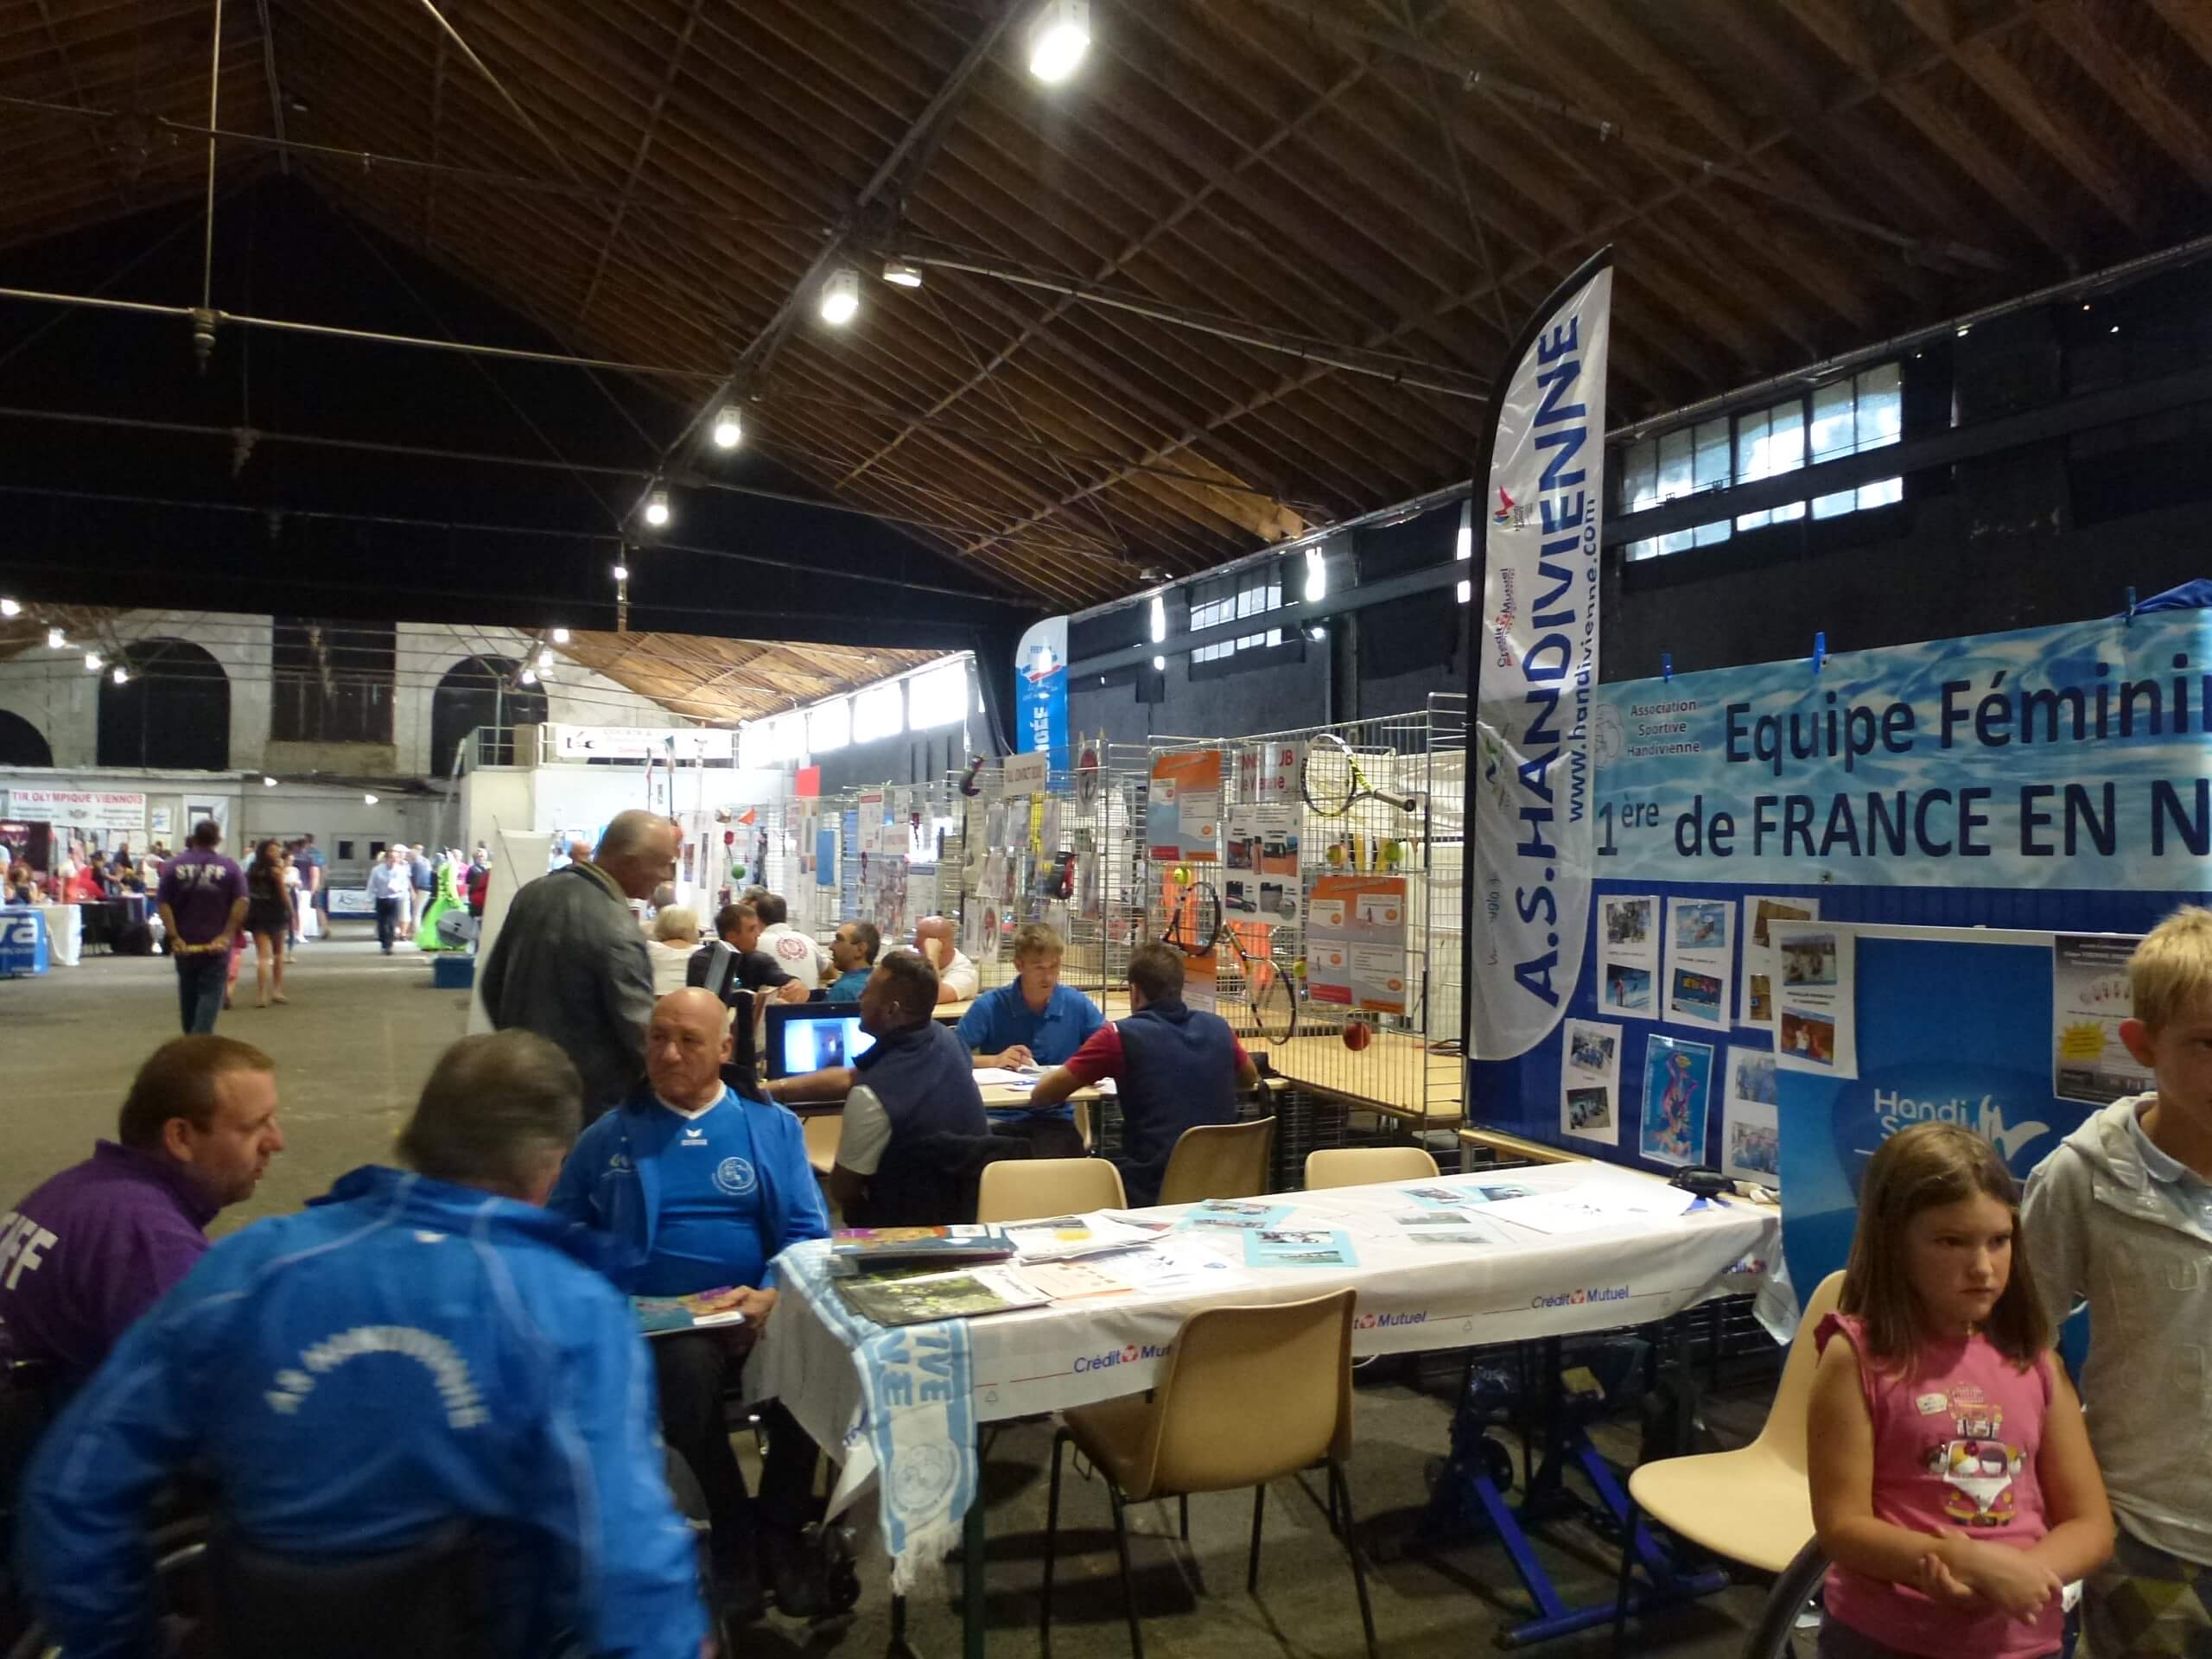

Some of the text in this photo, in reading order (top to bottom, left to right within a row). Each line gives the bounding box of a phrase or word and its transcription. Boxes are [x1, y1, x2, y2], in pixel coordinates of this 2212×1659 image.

[1514, 315, 1587, 1008] A.S.HANDIVIENNE
[1568, 498, 1597, 823] www.handivienne.com
[1630, 700, 1697, 717] Association
[1637, 722, 1688, 737] Sportive
[1726, 690, 1916, 777] Equipe
[1627, 742, 1701, 757] Handivienne
[32, 792, 92, 803] OLYMPIQUE
[96, 793, 144, 804] VIENNOIS
[1675, 794, 1735, 857] de
[1753, 787, 1993, 858] FRANCE
[2019, 781, 2116, 857] EN
[1873, 1088, 1967, 1128] Handi
[1587, 1285, 1629, 1303] Mutuel
[1377, 1311, 1427, 1327] Mutuel
[1141, 1344, 1172, 1359] Mut
